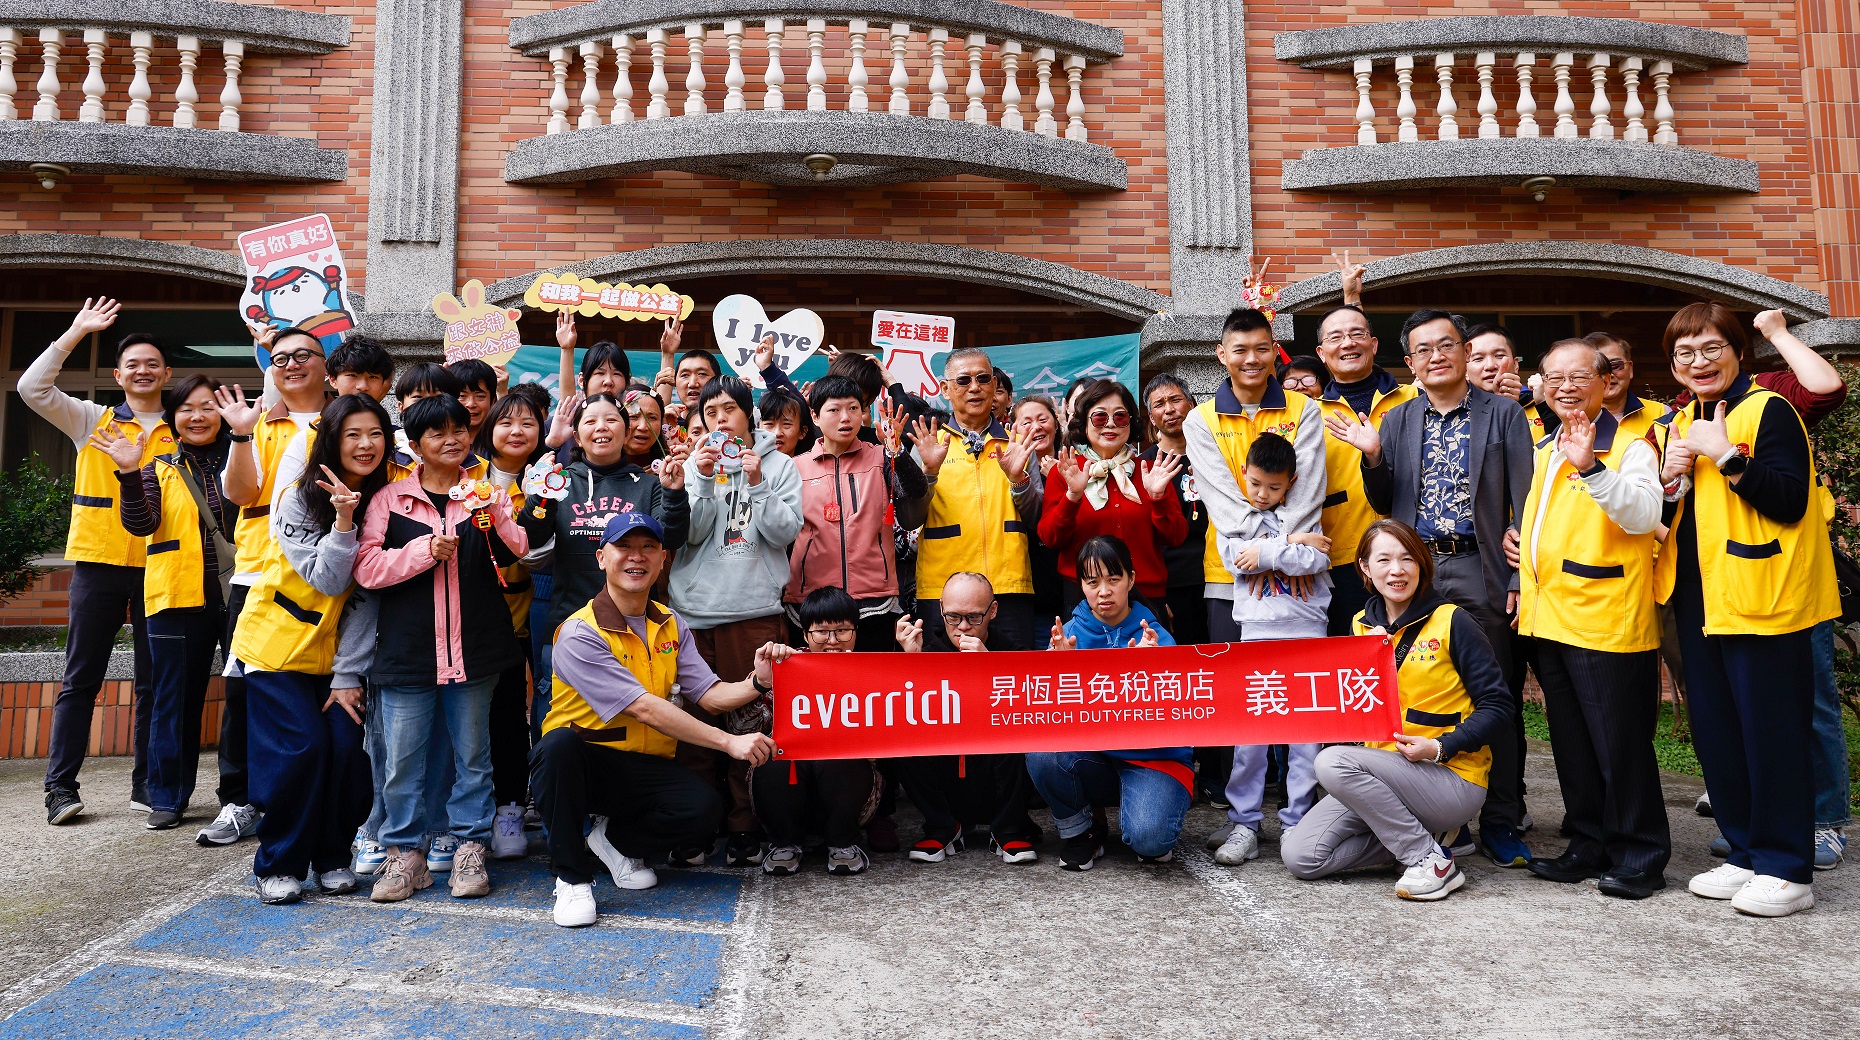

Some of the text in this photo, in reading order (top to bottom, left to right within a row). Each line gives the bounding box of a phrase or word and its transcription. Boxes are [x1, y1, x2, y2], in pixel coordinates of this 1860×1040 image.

[245, 223, 328, 259] 有你真好
[539, 282, 681, 313] 和我一起做公益
[447, 311, 505, 342] 跟女神
[725, 318, 812, 352] I love
[877, 320, 949, 343] 愛在這裡
[445, 330, 522, 364] 來做公益
[735, 348, 790, 370] yu
[476, 510, 491, 529] 吉
[571, 496, 635, 516] CHEER
[791, 680, 961, 729] everrich
[990, 667, 1384, 716] 昇恆昌免稅商店 義工隊
[991, 706, 1215, 726] EVERRICH DUTYFREE SHOP
